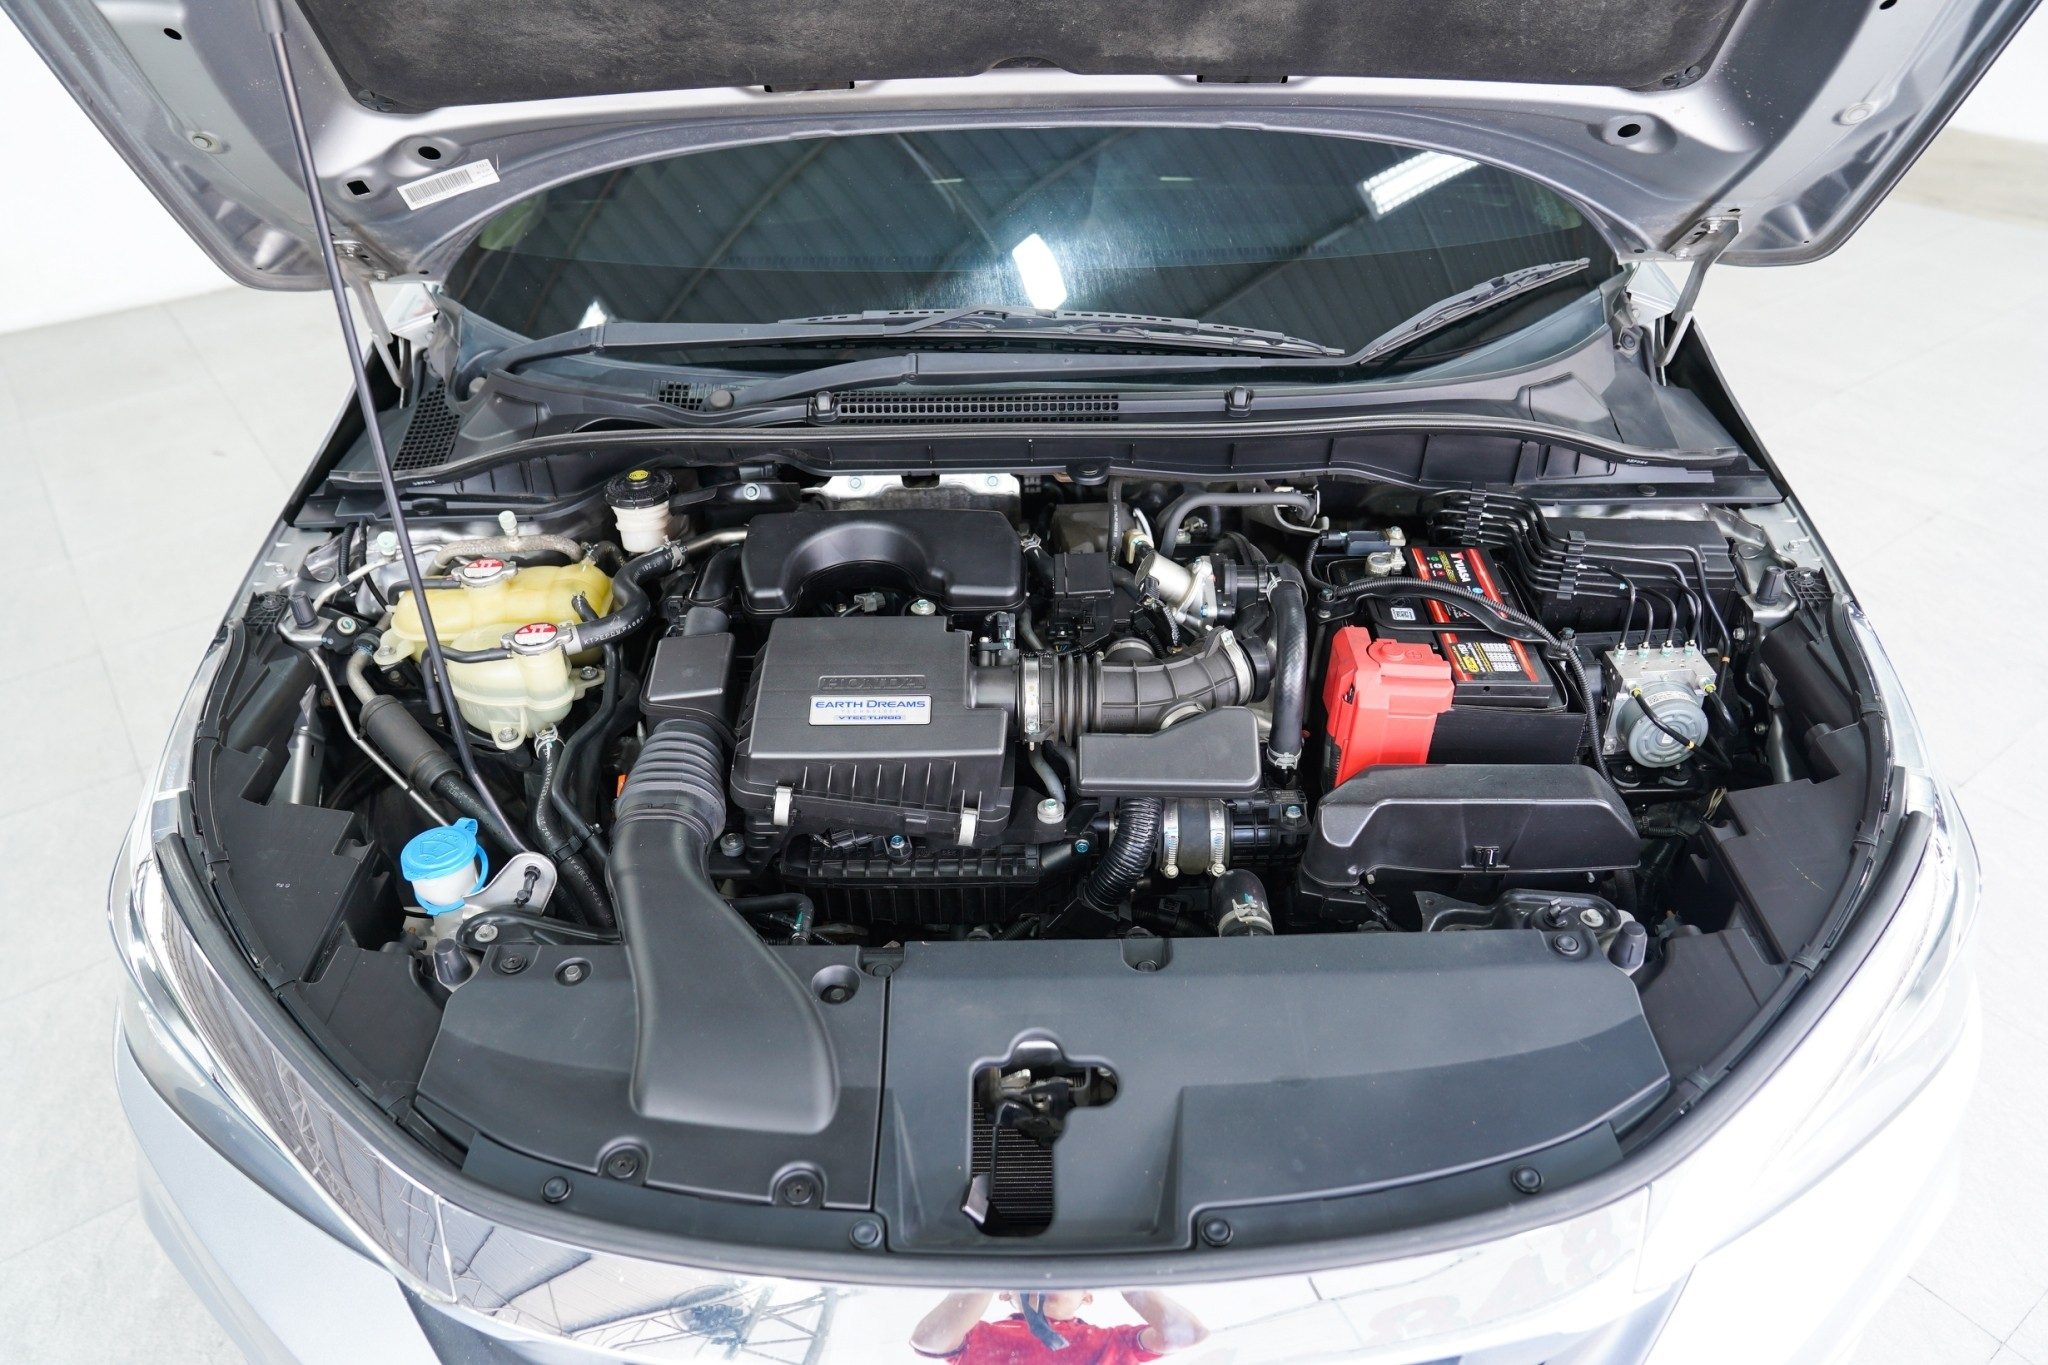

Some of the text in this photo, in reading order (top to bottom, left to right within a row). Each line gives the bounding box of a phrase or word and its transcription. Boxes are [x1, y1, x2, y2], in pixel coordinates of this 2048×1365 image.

[1454, 560, 1471, 582] YUASA
[815, 699, 926, 708] EARTH DREAMS
